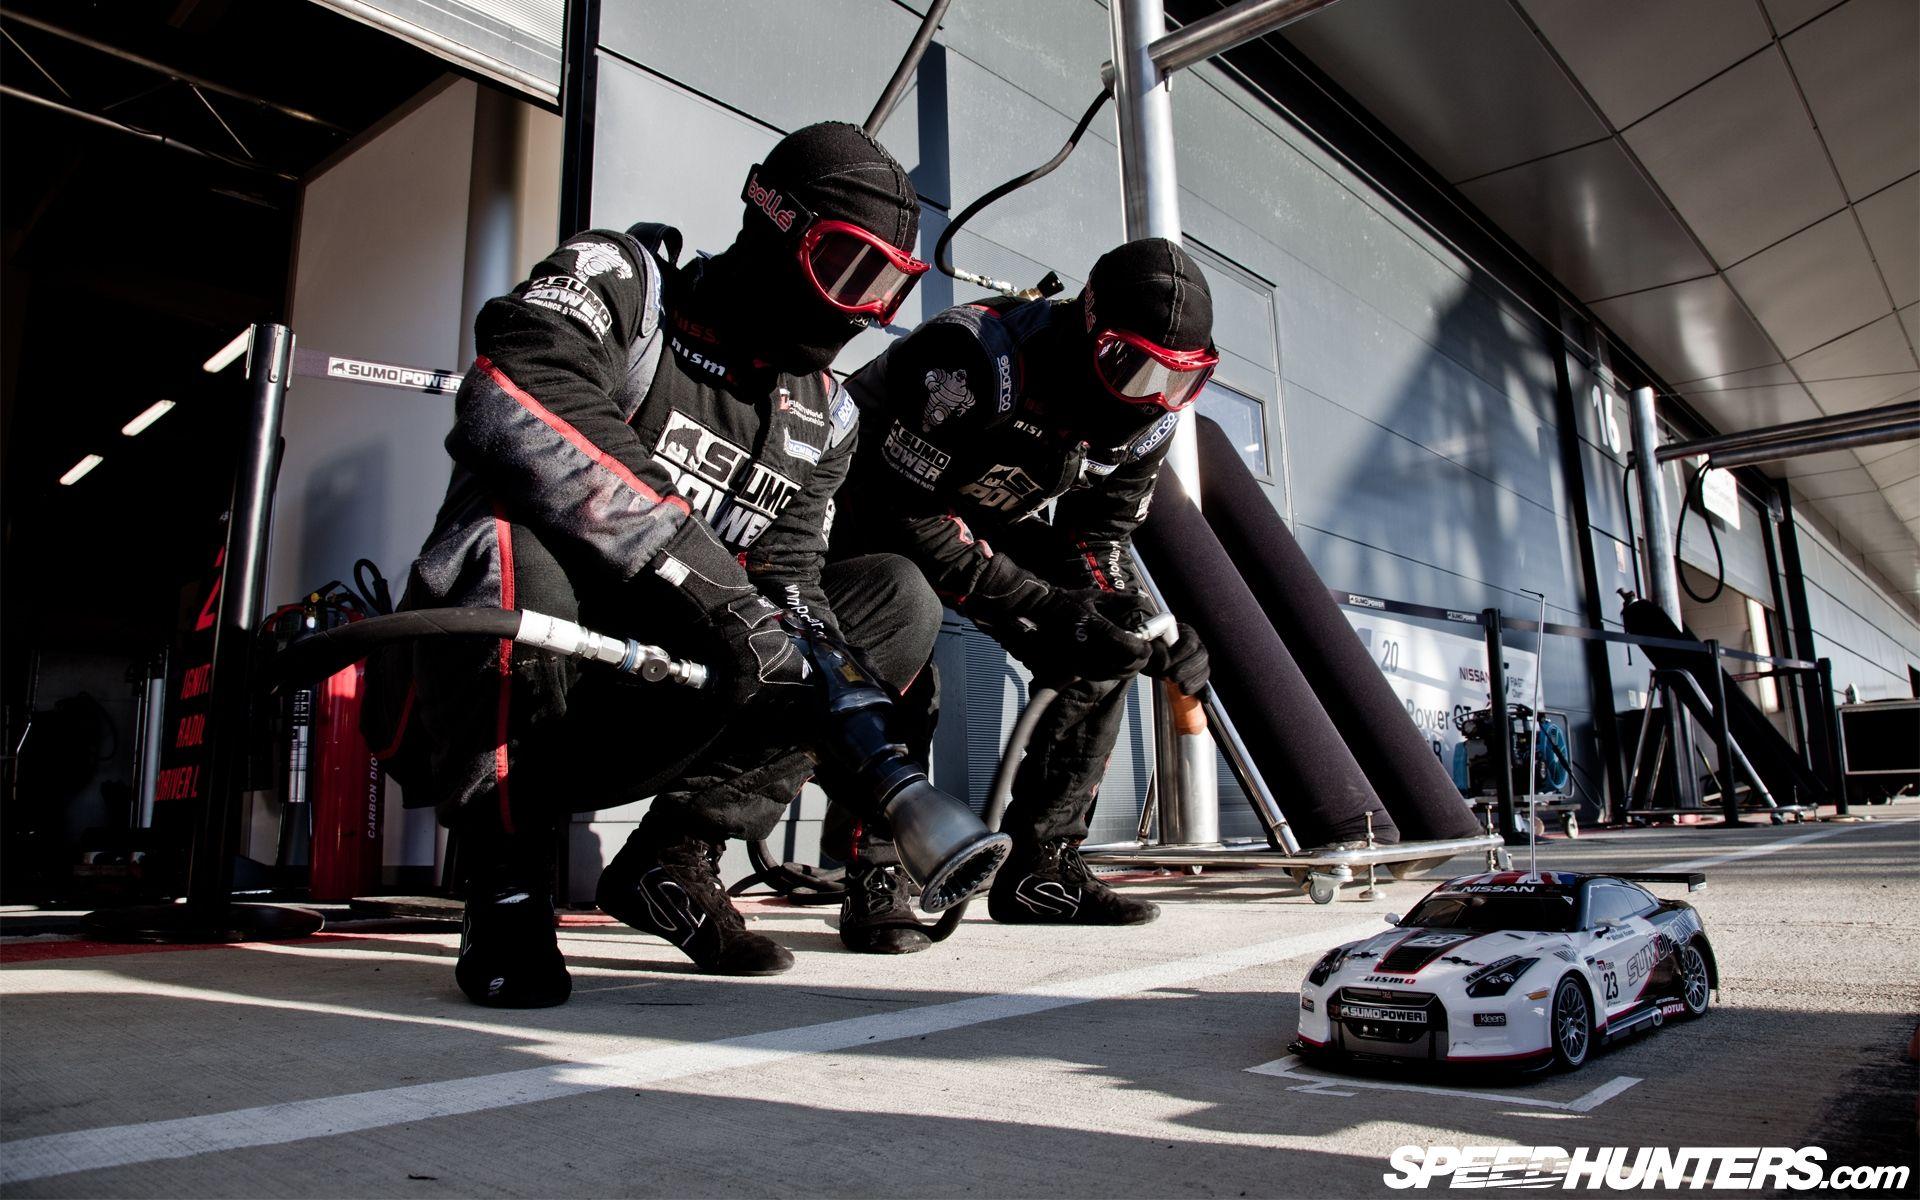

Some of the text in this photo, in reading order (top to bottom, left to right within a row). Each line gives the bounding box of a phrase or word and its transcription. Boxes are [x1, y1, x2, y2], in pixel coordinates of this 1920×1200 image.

[998, 355, 1012, 413] sparco
[1136, 412, 1177, 456] sparco
[1592, 384, 1621, 454] 16
[885, 435, 941, 481] POWER
[1381, 640, 1399, 673] 20
[368, 784, 377, 839] CARBON
[1604, 971, 1619, 1000] 23
[1663, 1003, 1685, 1014] MOTUL
